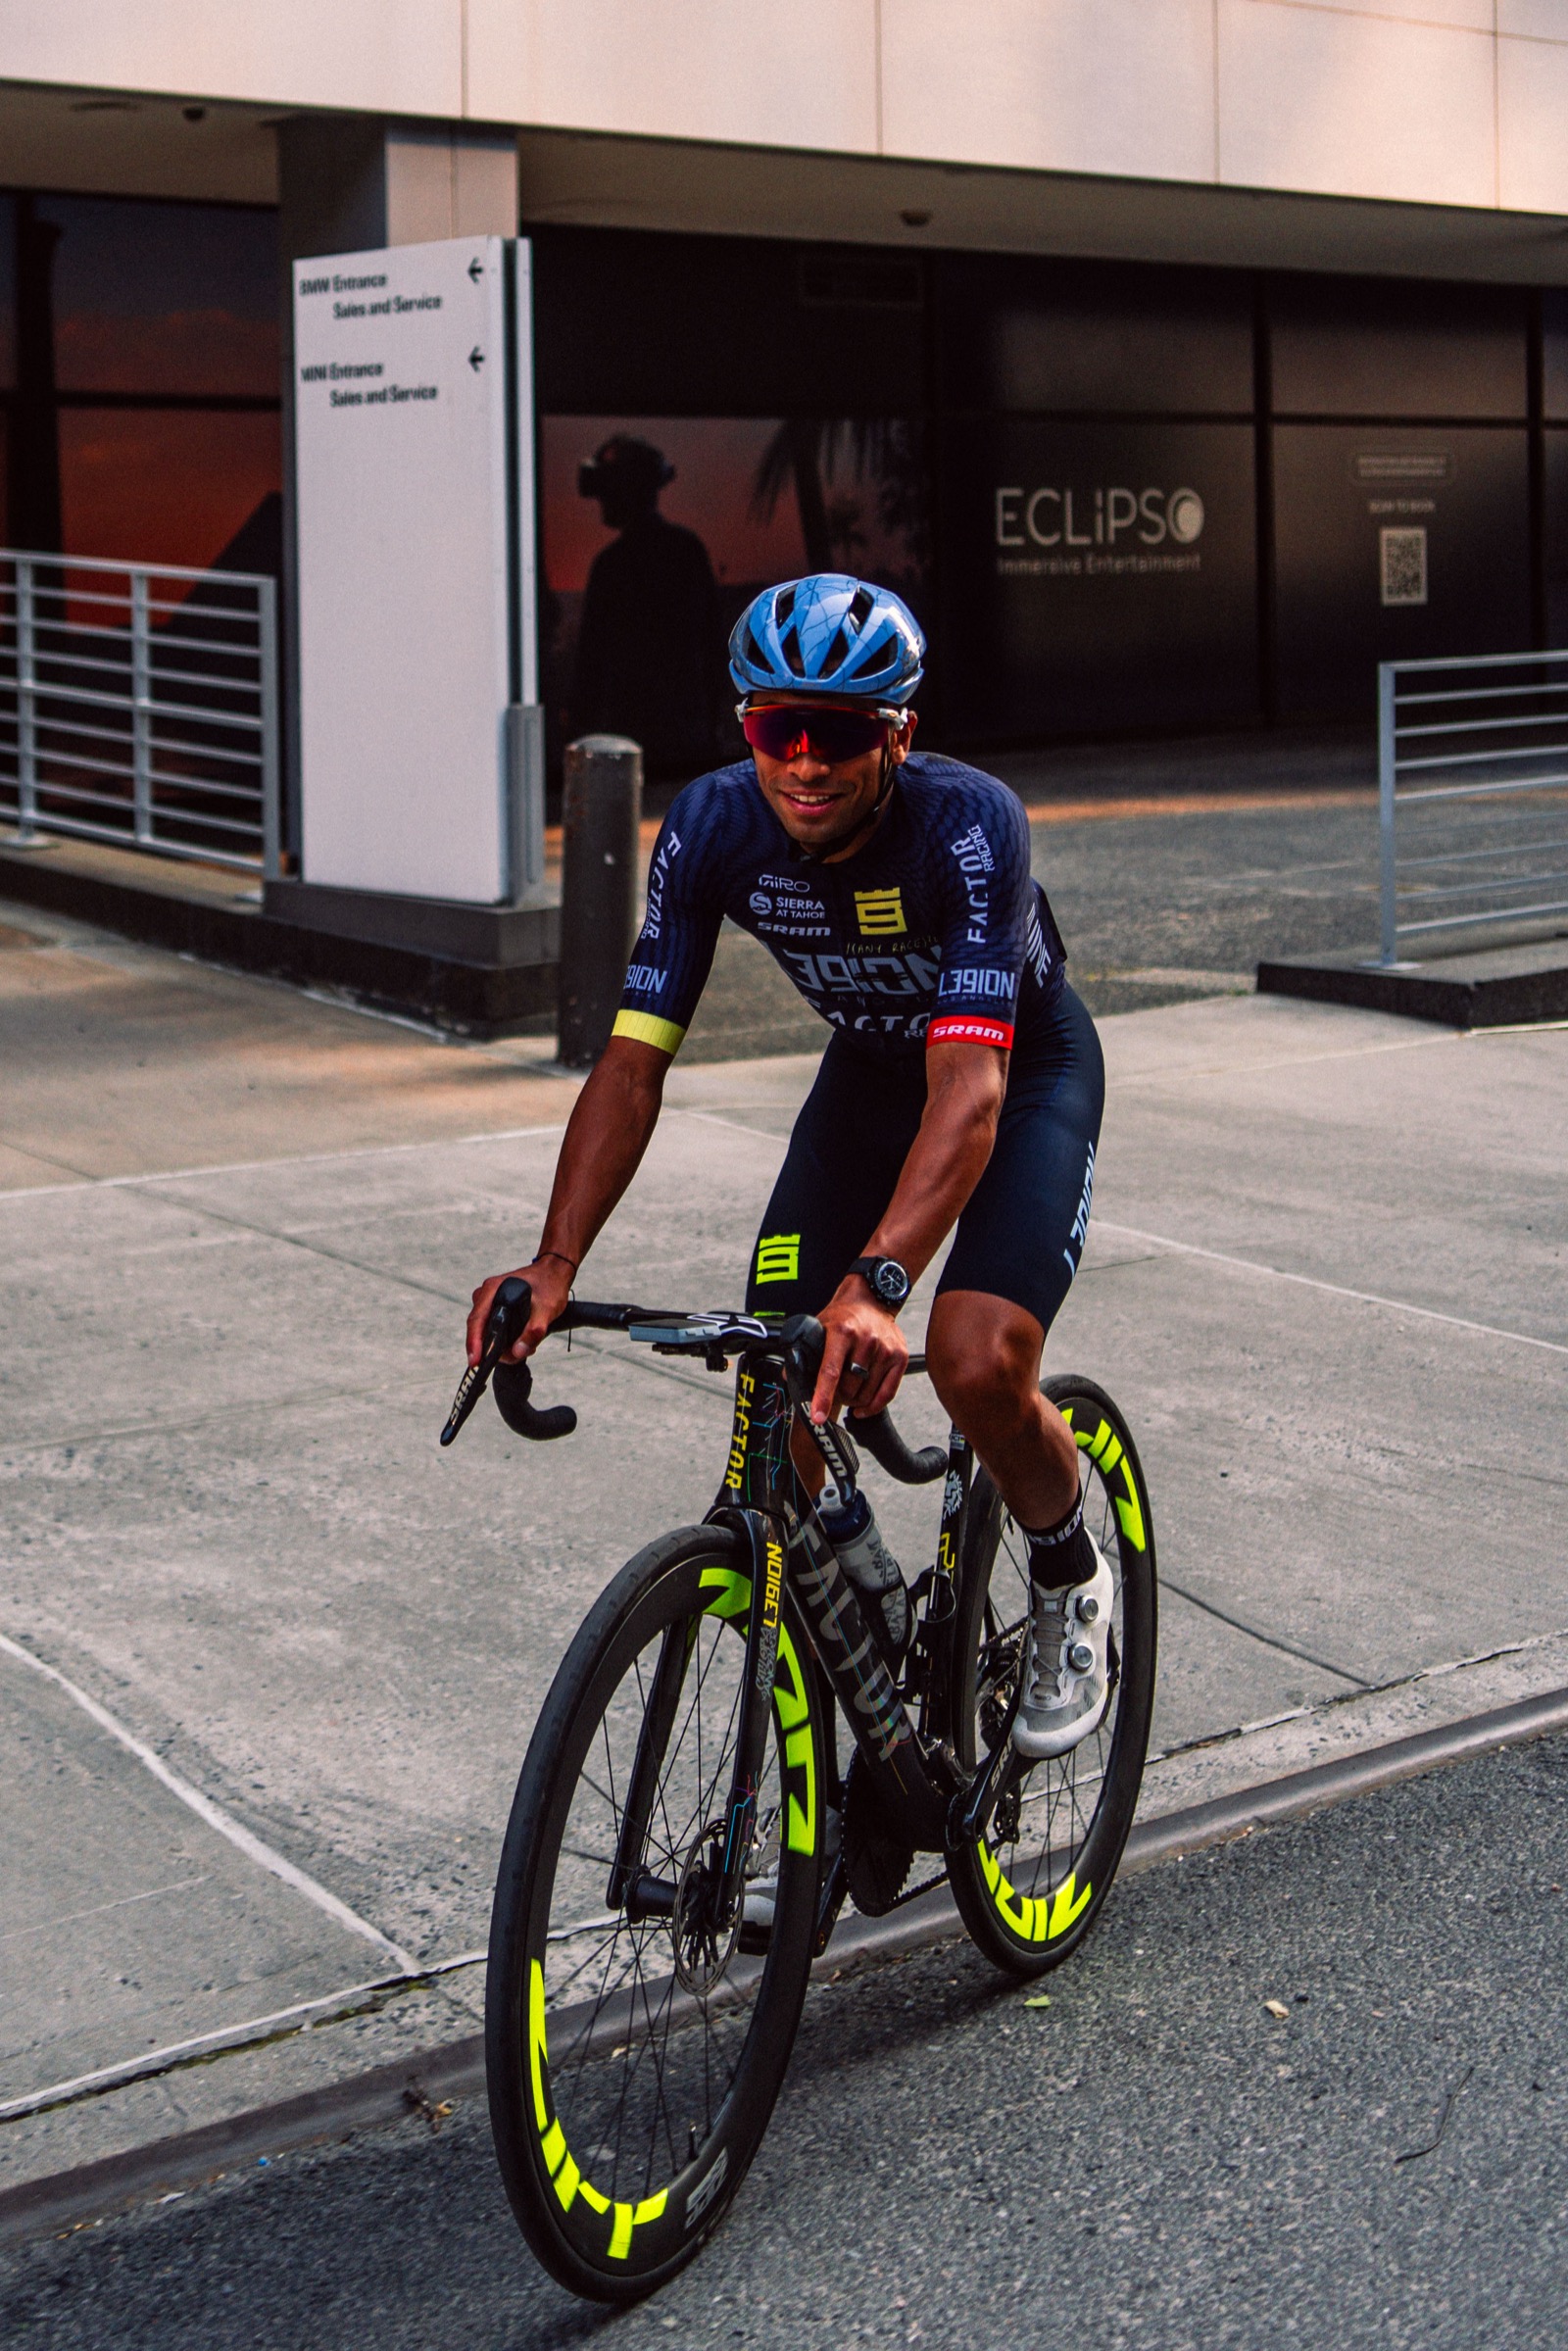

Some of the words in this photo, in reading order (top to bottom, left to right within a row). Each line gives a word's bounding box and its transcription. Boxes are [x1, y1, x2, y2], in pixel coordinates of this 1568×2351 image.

[300, 279, 330, 295] BMW
[333, 274, 386, 291] Entrance
[333, 301, 366, 318] Sales
[369, 299, 390, 316] and
[393, 296, 441, 312] Service
[301, 365, 326, 382] MINI
[329, 364, 382, 379] Entrance
[330, 390, 362, 407] Sales
[366, 388, 385, 404] and
[388, 385, 437, 401] Service
[998, 556, 1082, 576] Immersive
[1085, 551, 1202, 574] Entertainment
[649, 831, 682, 940] FACTOR
[951, 836, 989, 944] FACTOR
[776, 896, 825, 910] SIERRA
[790, 910, 826, 919] TAHOE
[757, 921, 831, 937] SRAM
[933, 1024, 1004, 1042] SRAM
[725, 1373, 756, 1489] FACTOR
